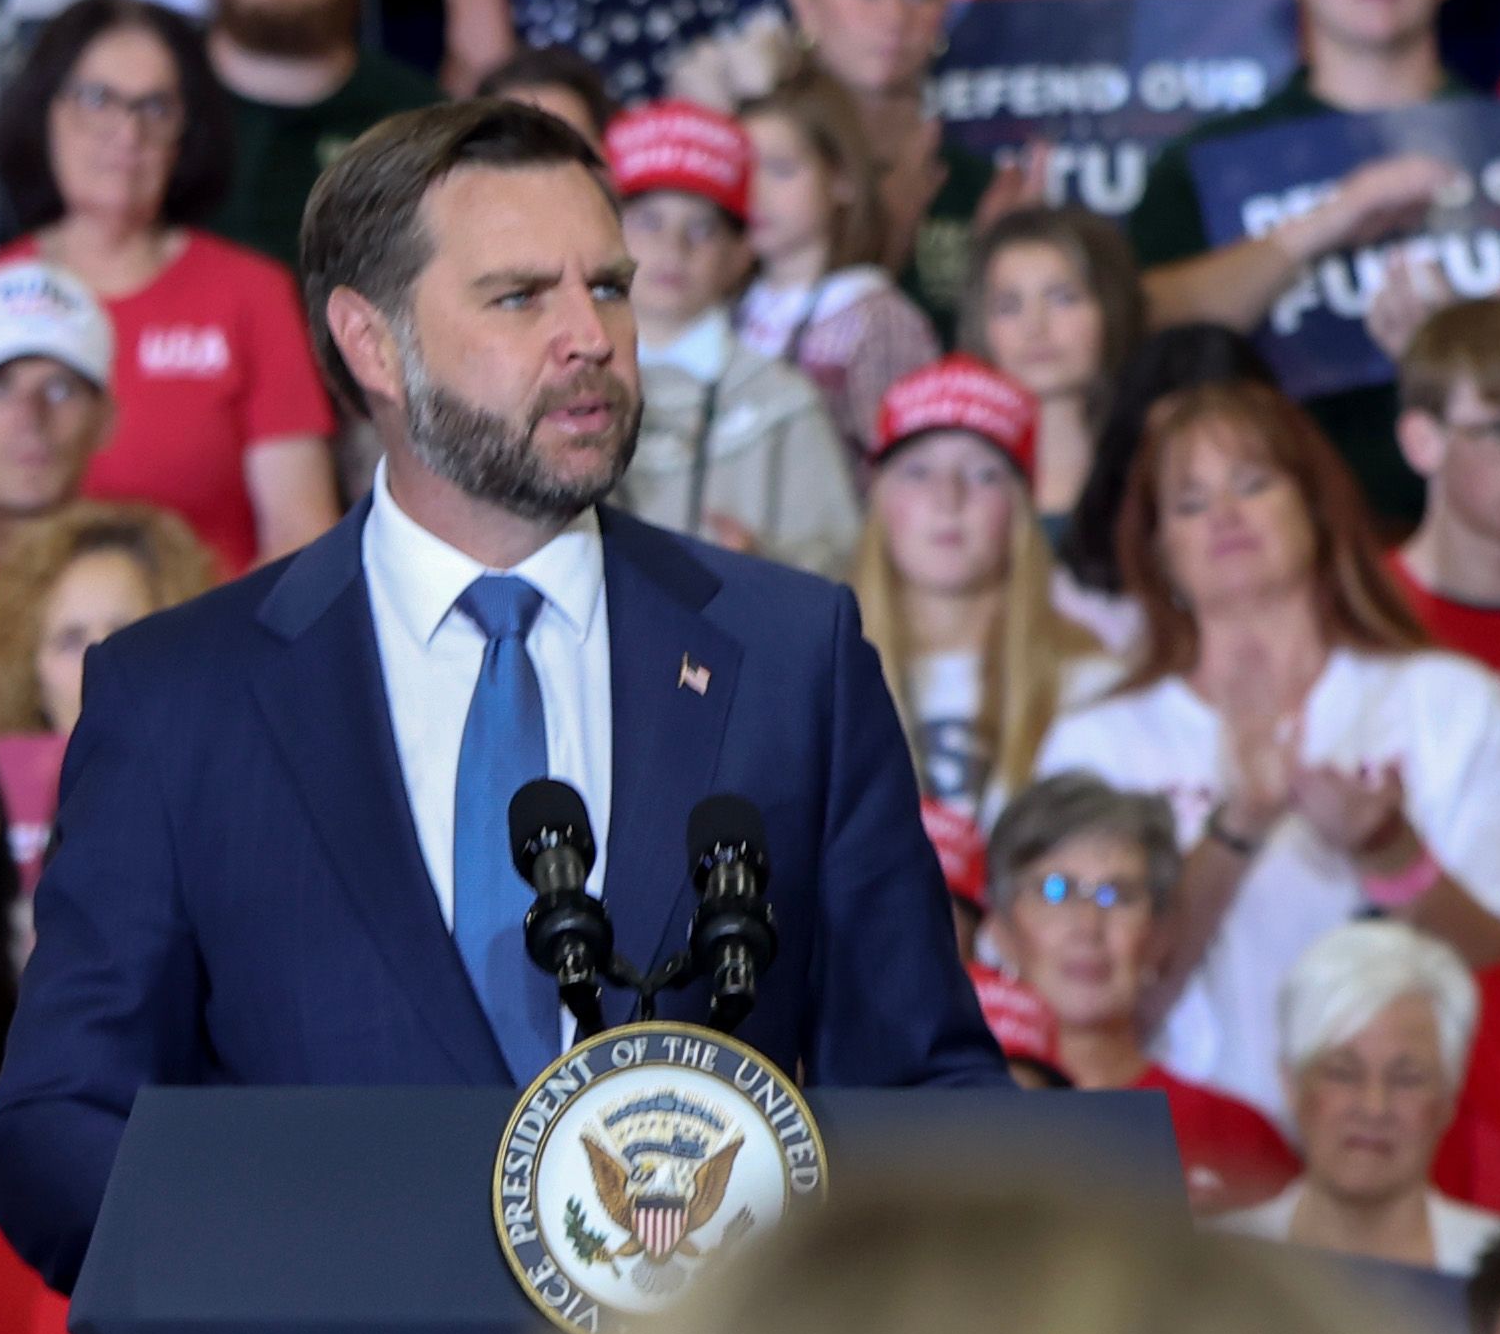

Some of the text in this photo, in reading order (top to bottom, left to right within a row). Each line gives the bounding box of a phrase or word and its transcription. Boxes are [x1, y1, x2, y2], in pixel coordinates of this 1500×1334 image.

[502, 1051, 592, 1246] PRESIDENT
[611, 1035, 649, 1067] OF
[661, 1035, 720, 1072] THE
[733, 1057, 820, 1195] UNITED
